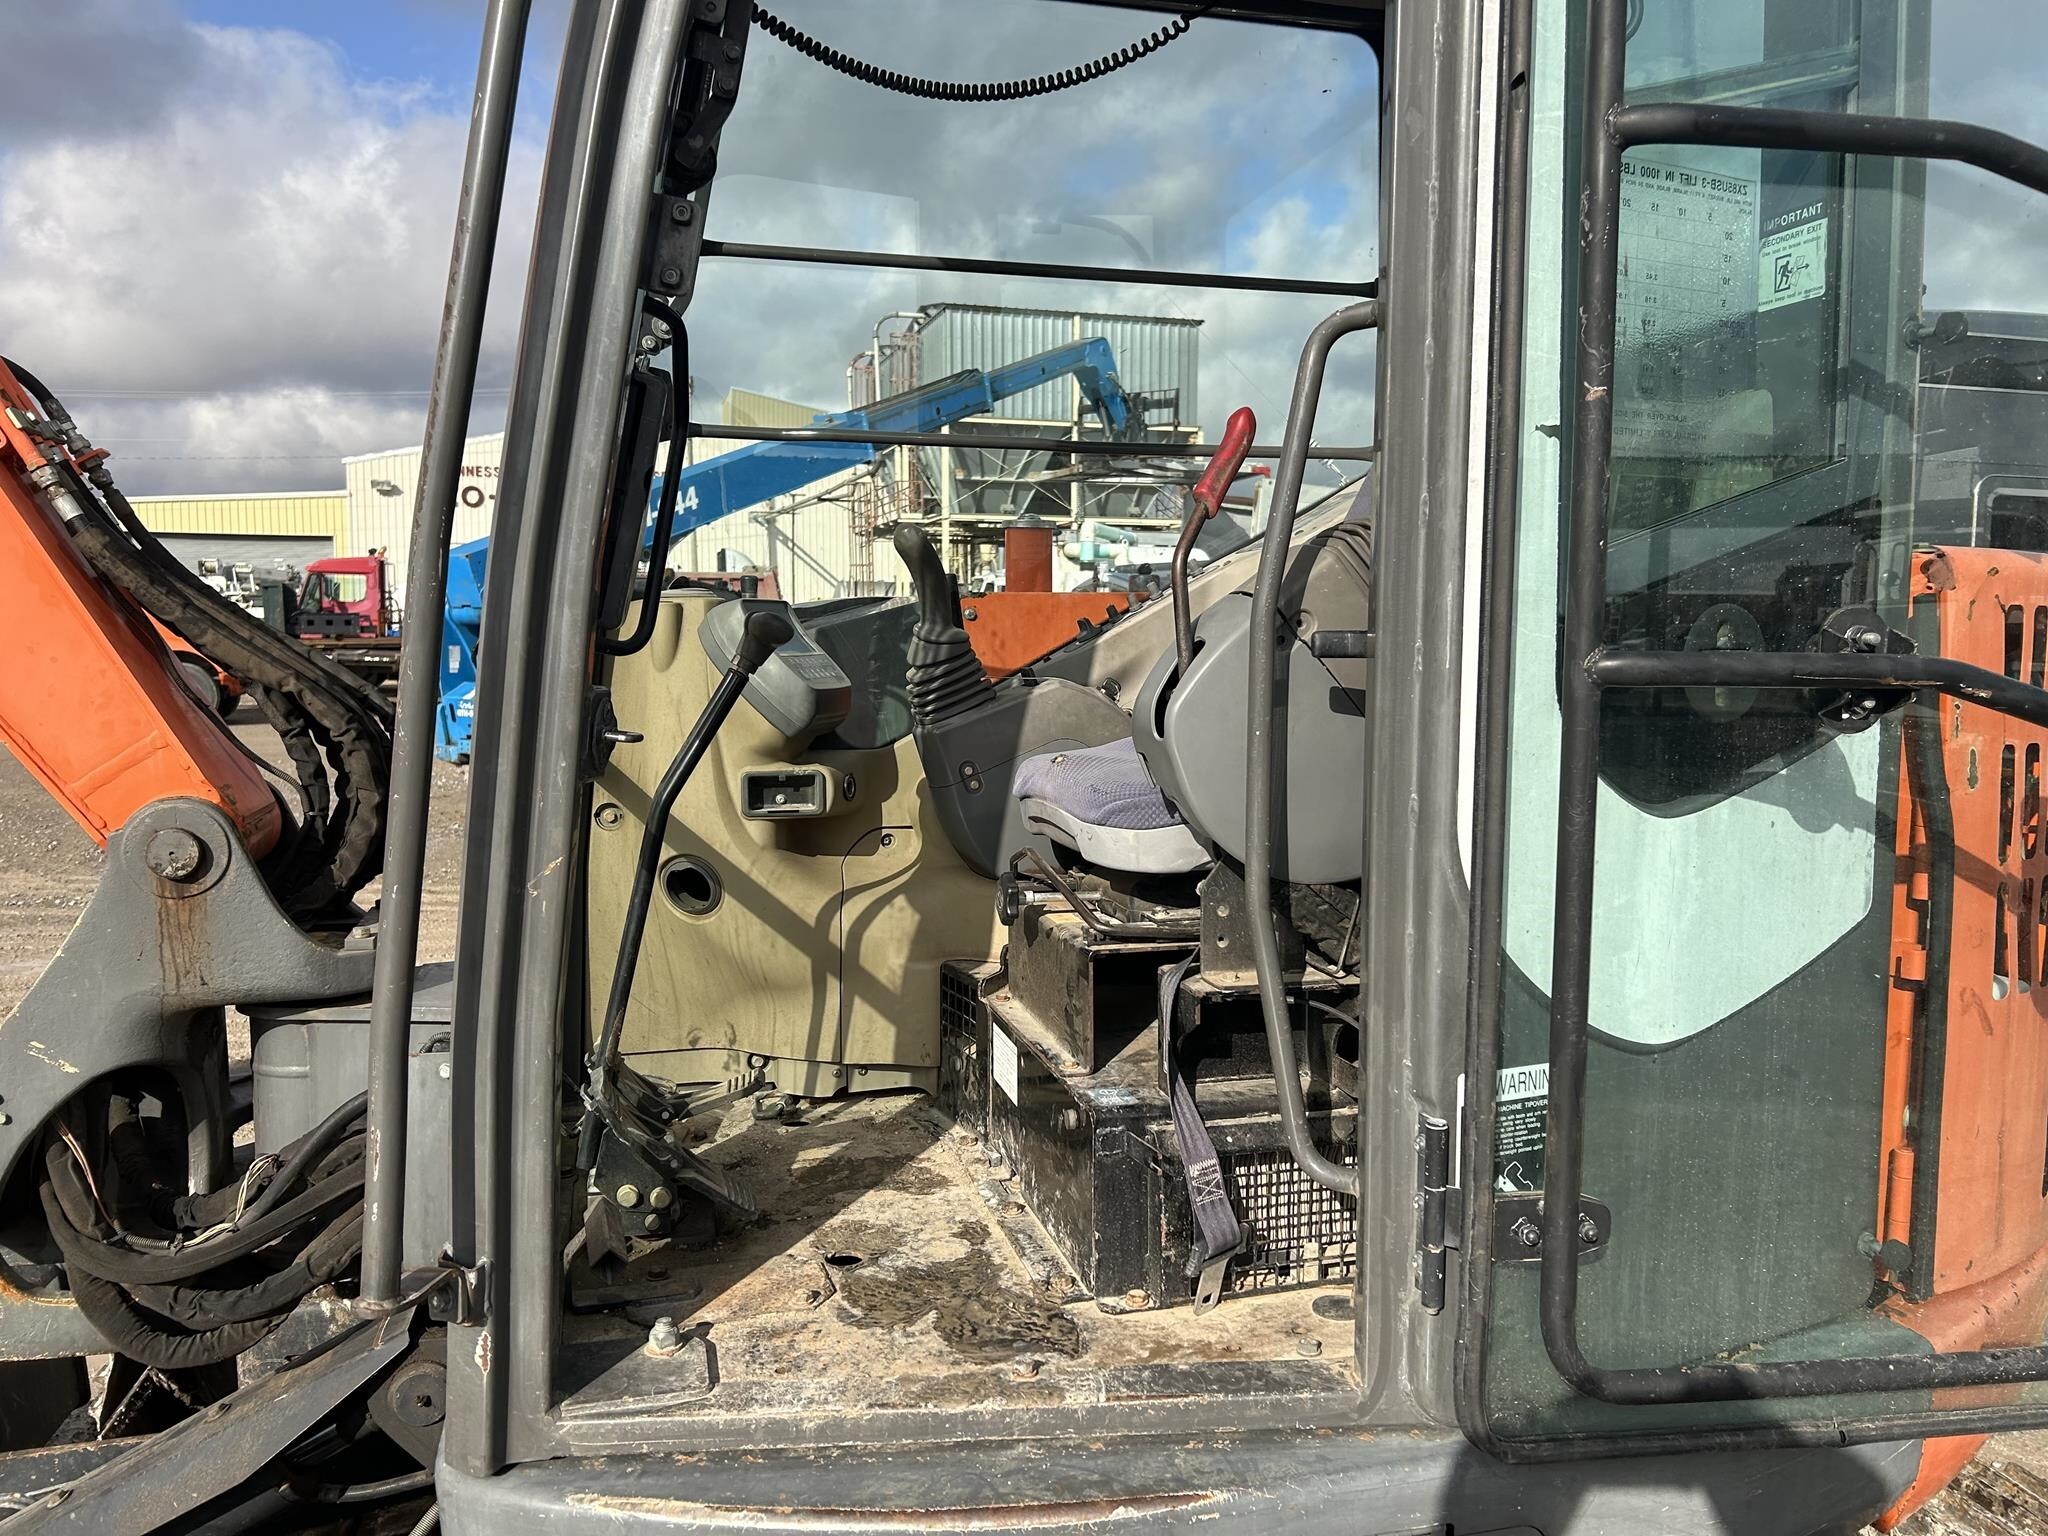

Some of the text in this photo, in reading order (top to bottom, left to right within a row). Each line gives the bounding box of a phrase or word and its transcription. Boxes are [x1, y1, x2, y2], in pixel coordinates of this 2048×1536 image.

[1763, 202, 1823, 232] IMPORTANT
[1761, 223, 1823, 249] SECONDARY EXIT
